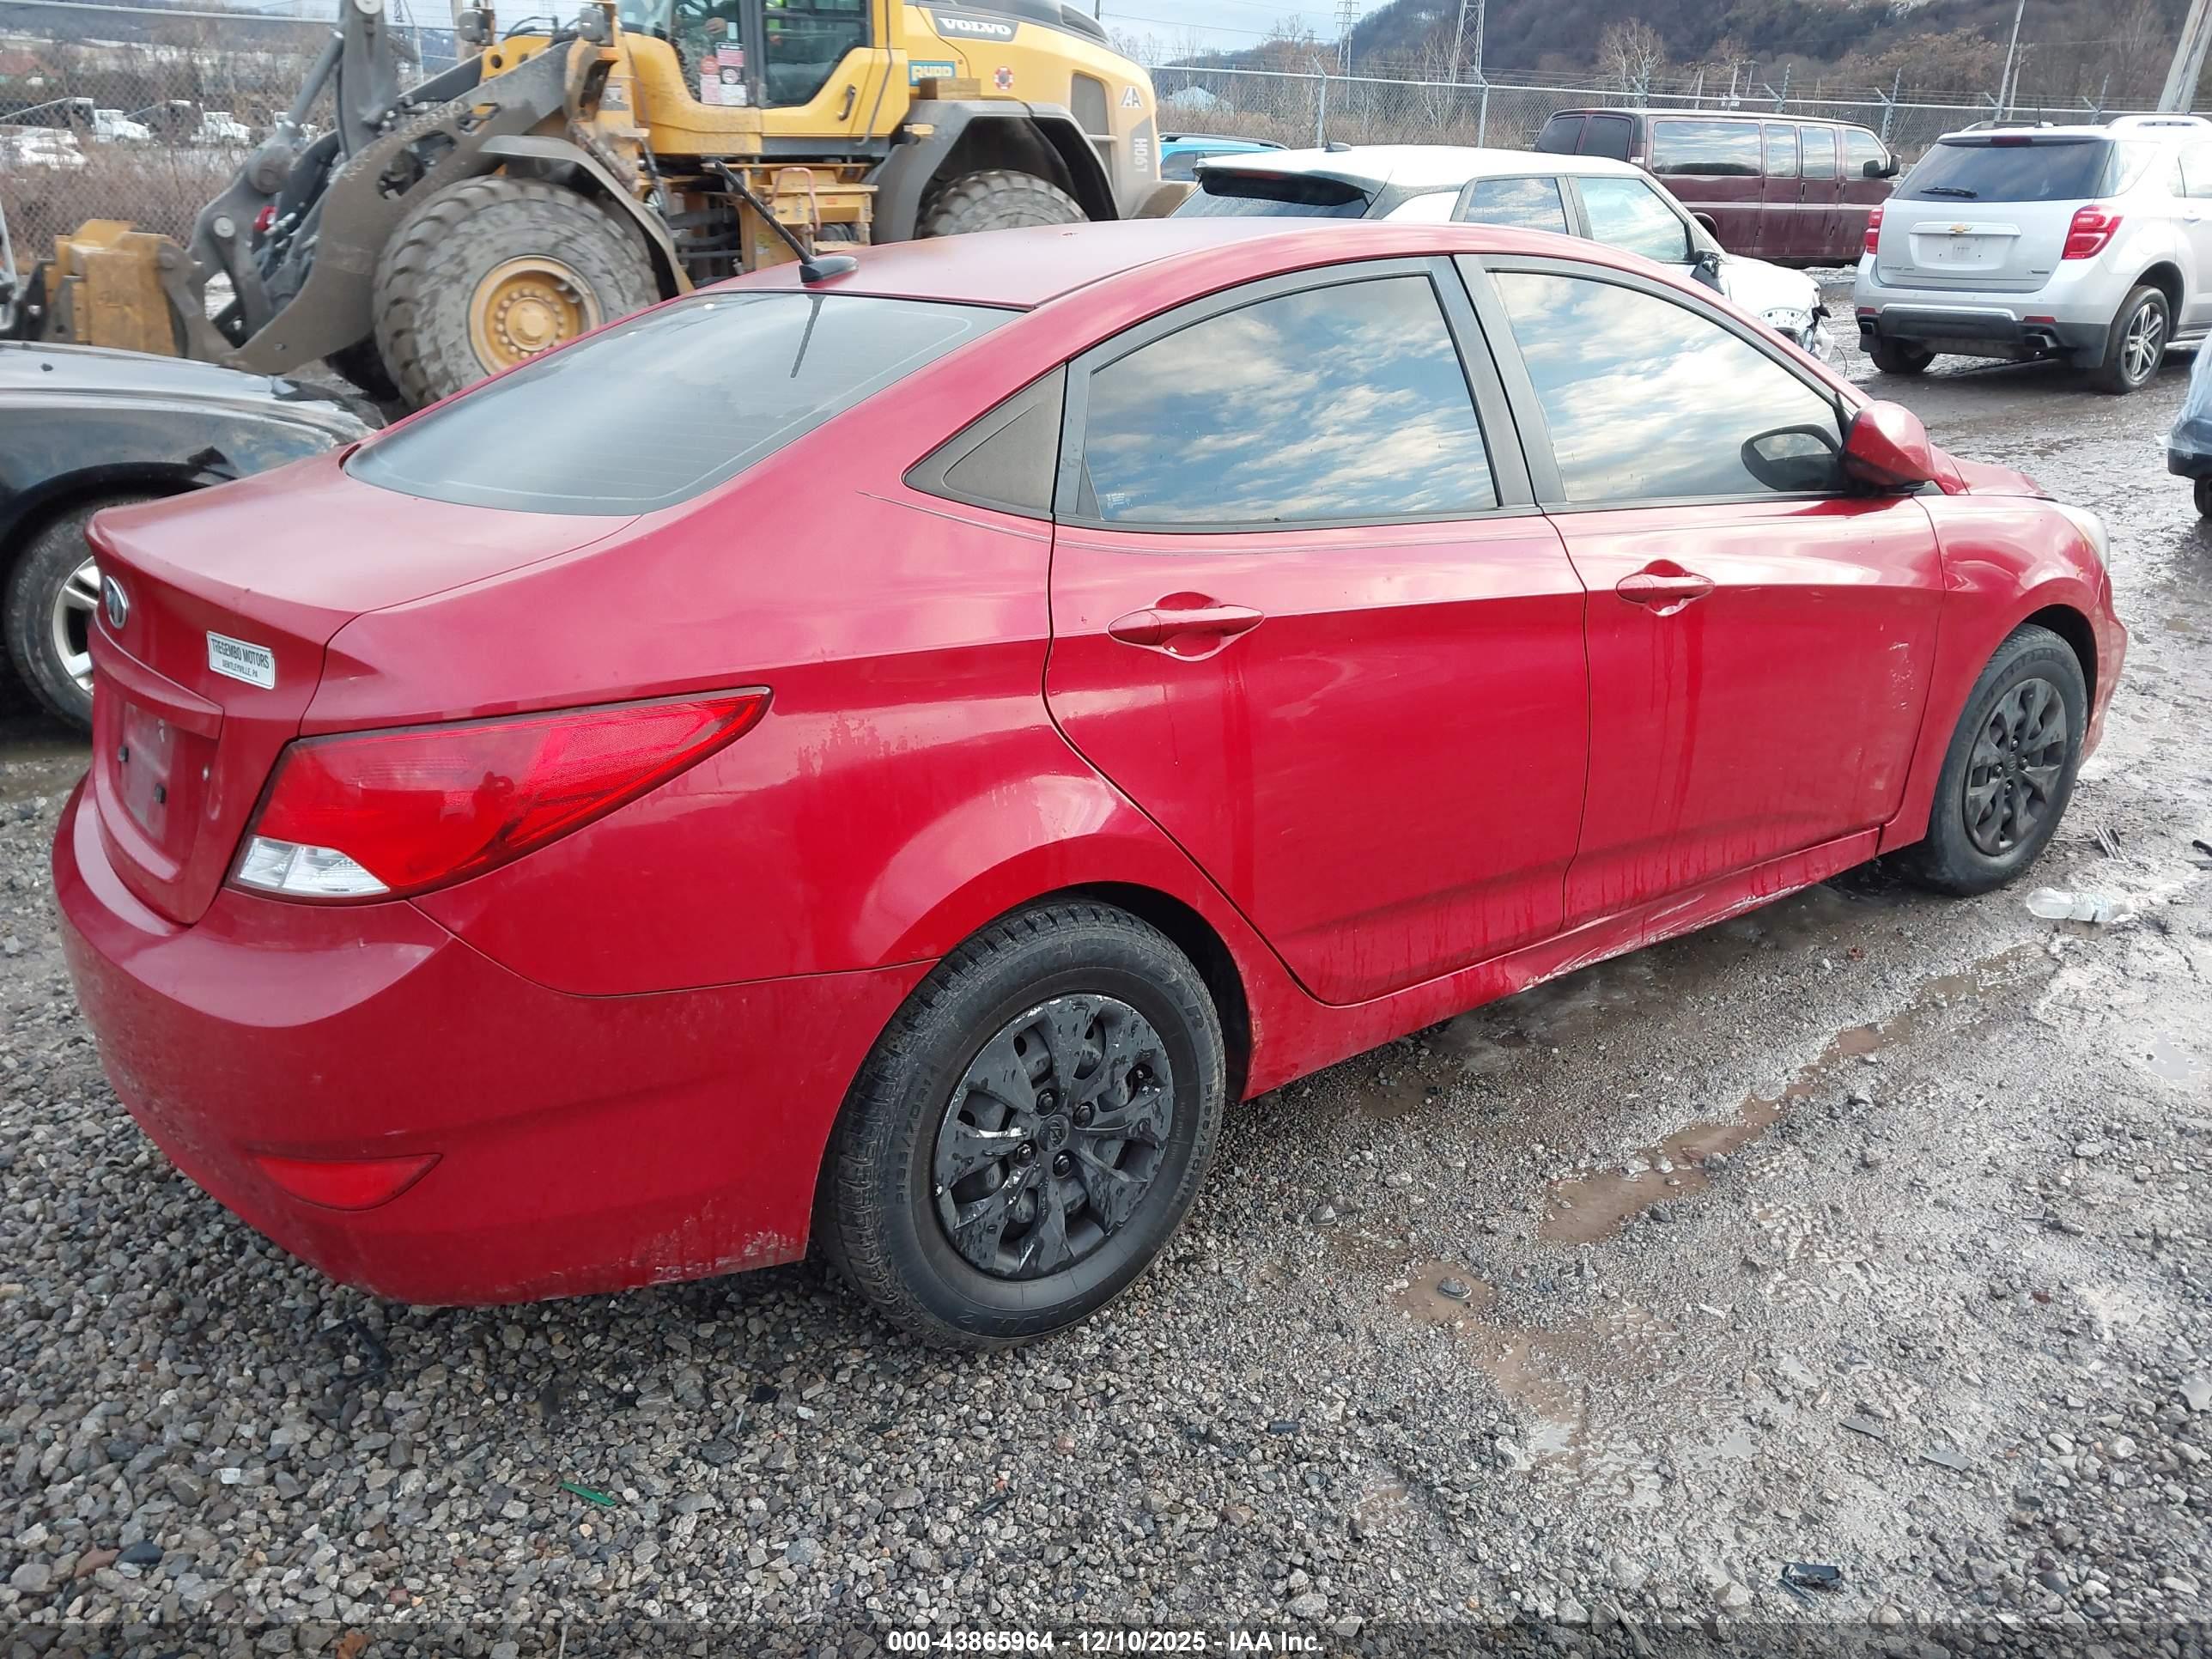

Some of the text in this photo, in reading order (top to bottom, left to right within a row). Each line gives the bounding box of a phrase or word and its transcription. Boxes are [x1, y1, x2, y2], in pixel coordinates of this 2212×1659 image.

[938, 17, 1012, 35] VOLVO
[1133, 137, 1148, 173] L90H
[211, 638, 270, 670] TREGEMBO MOTORS
